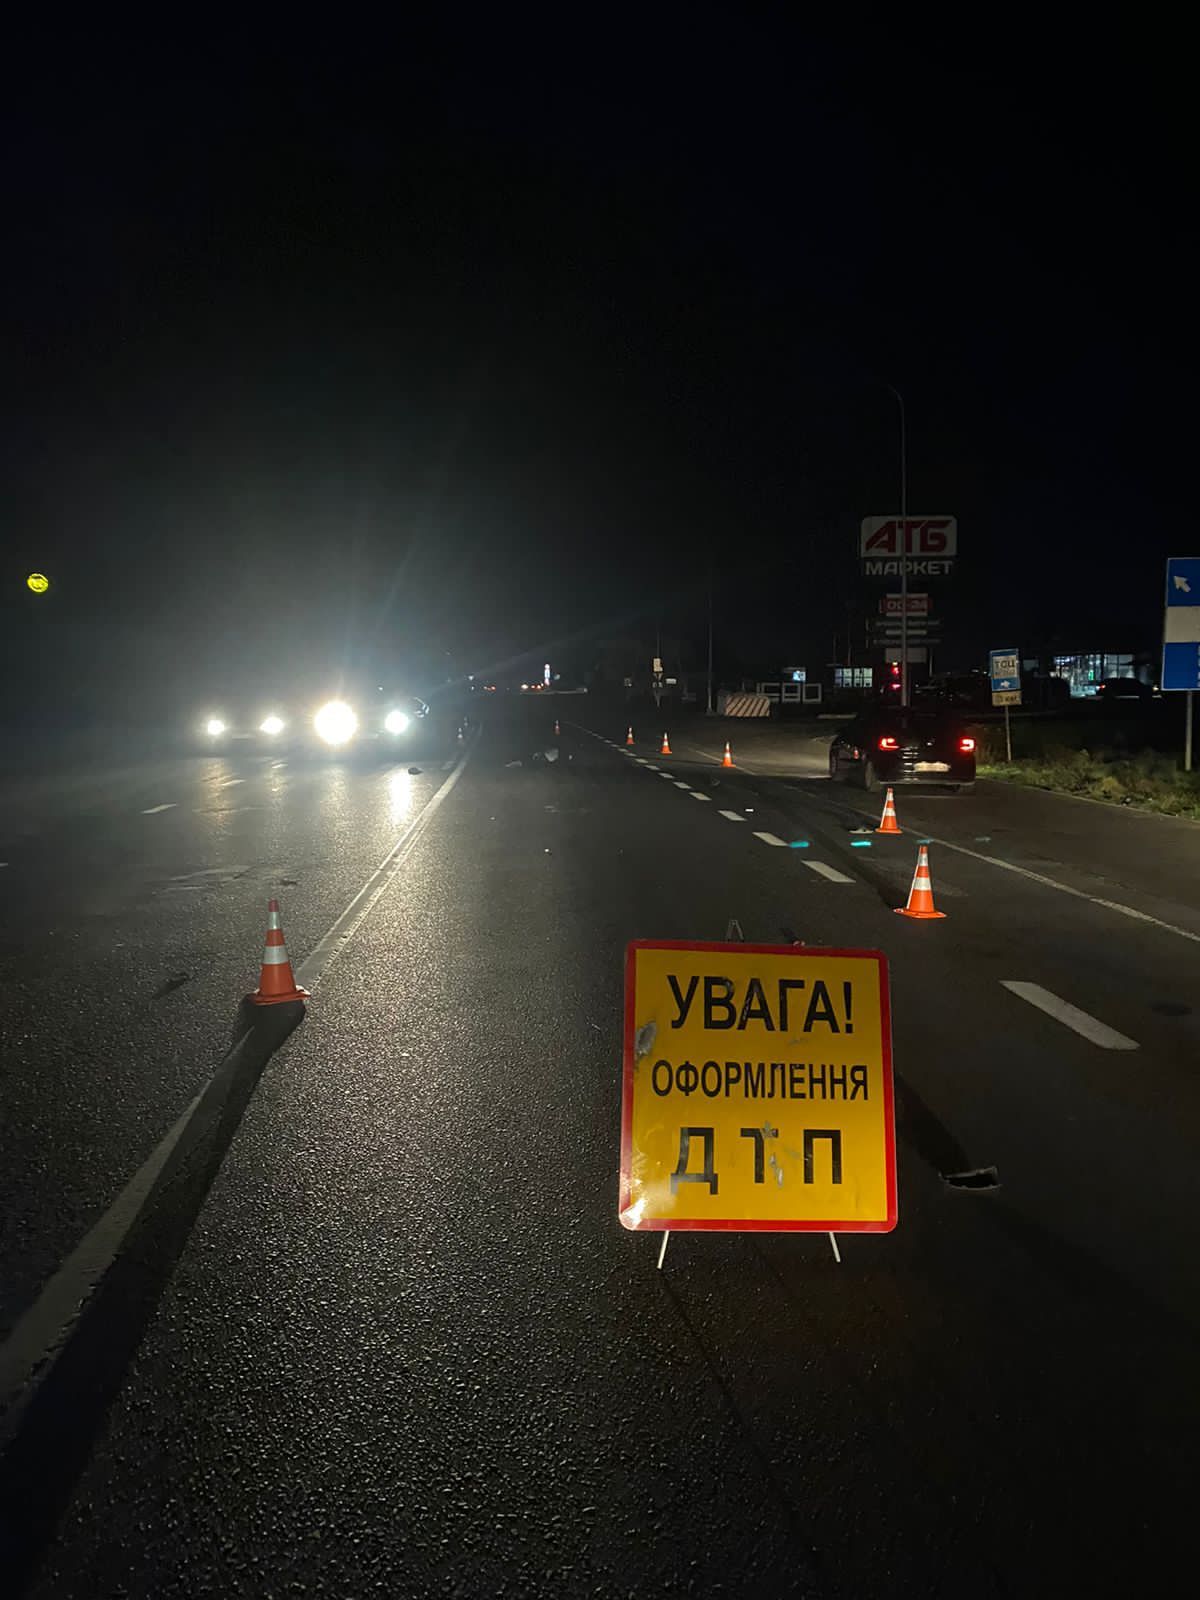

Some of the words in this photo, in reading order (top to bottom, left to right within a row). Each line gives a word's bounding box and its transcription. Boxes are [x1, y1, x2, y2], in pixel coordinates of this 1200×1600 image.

[866, 520, 952, 553] АТБ
[865, 560, 953, 576] МАРКЕТ
[667, 975, 854, 1034] УВАГА!
[652, 1060, 869, 1101] ОФОРМЛЕННЯ
